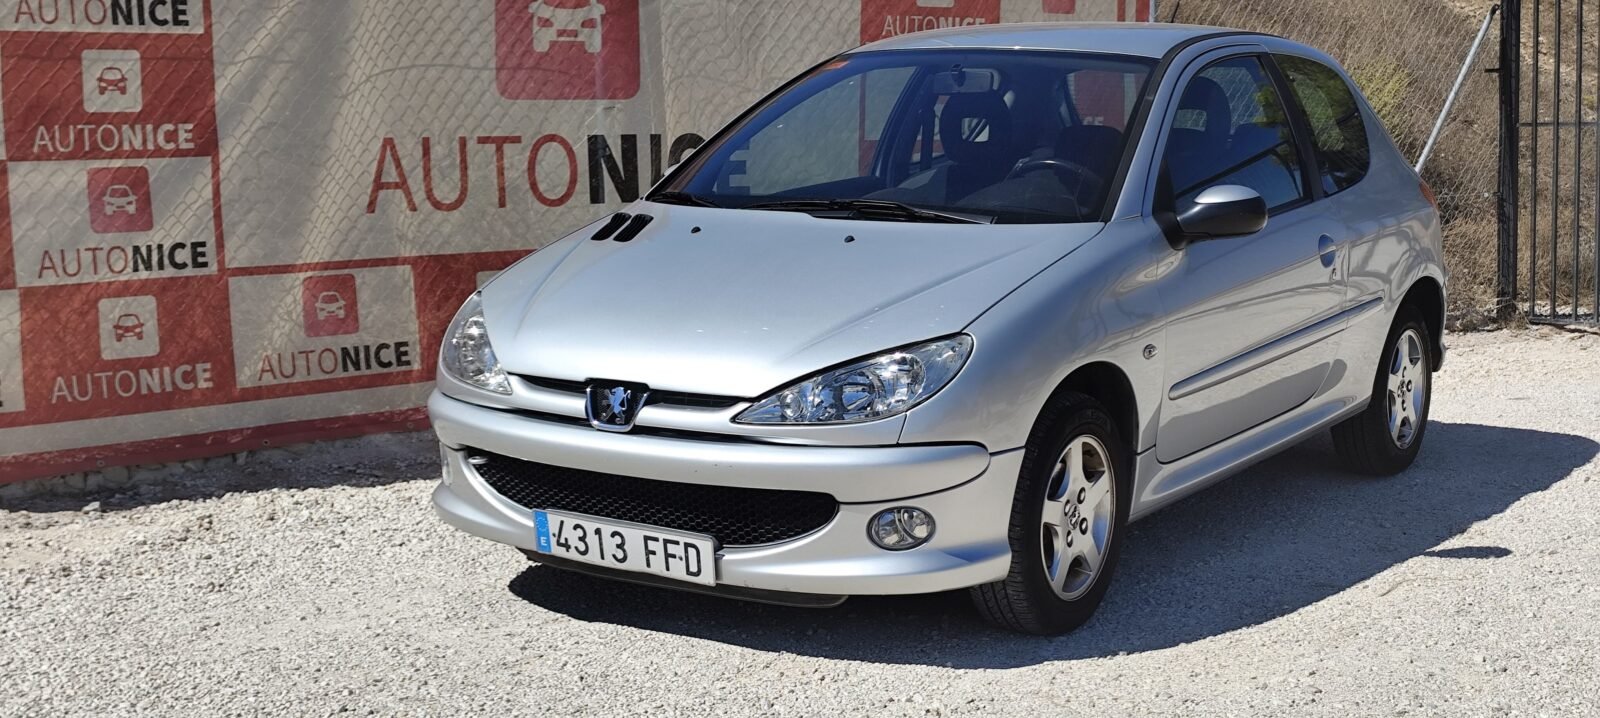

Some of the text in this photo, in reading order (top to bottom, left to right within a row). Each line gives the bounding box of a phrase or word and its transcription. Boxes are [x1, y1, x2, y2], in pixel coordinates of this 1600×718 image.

[14, 0, 190, 26] AUTONICE
[32, 123, 195, 153] AUTONICE
[37, 241, 209, 279] AUTONICE
[258, 341, 412, 381] AUTONICE
[51, 363, 213, 404] AUTONICE
[540, 536, 548, 547] E
[555, 519, 702, 577] 4313 FFD
